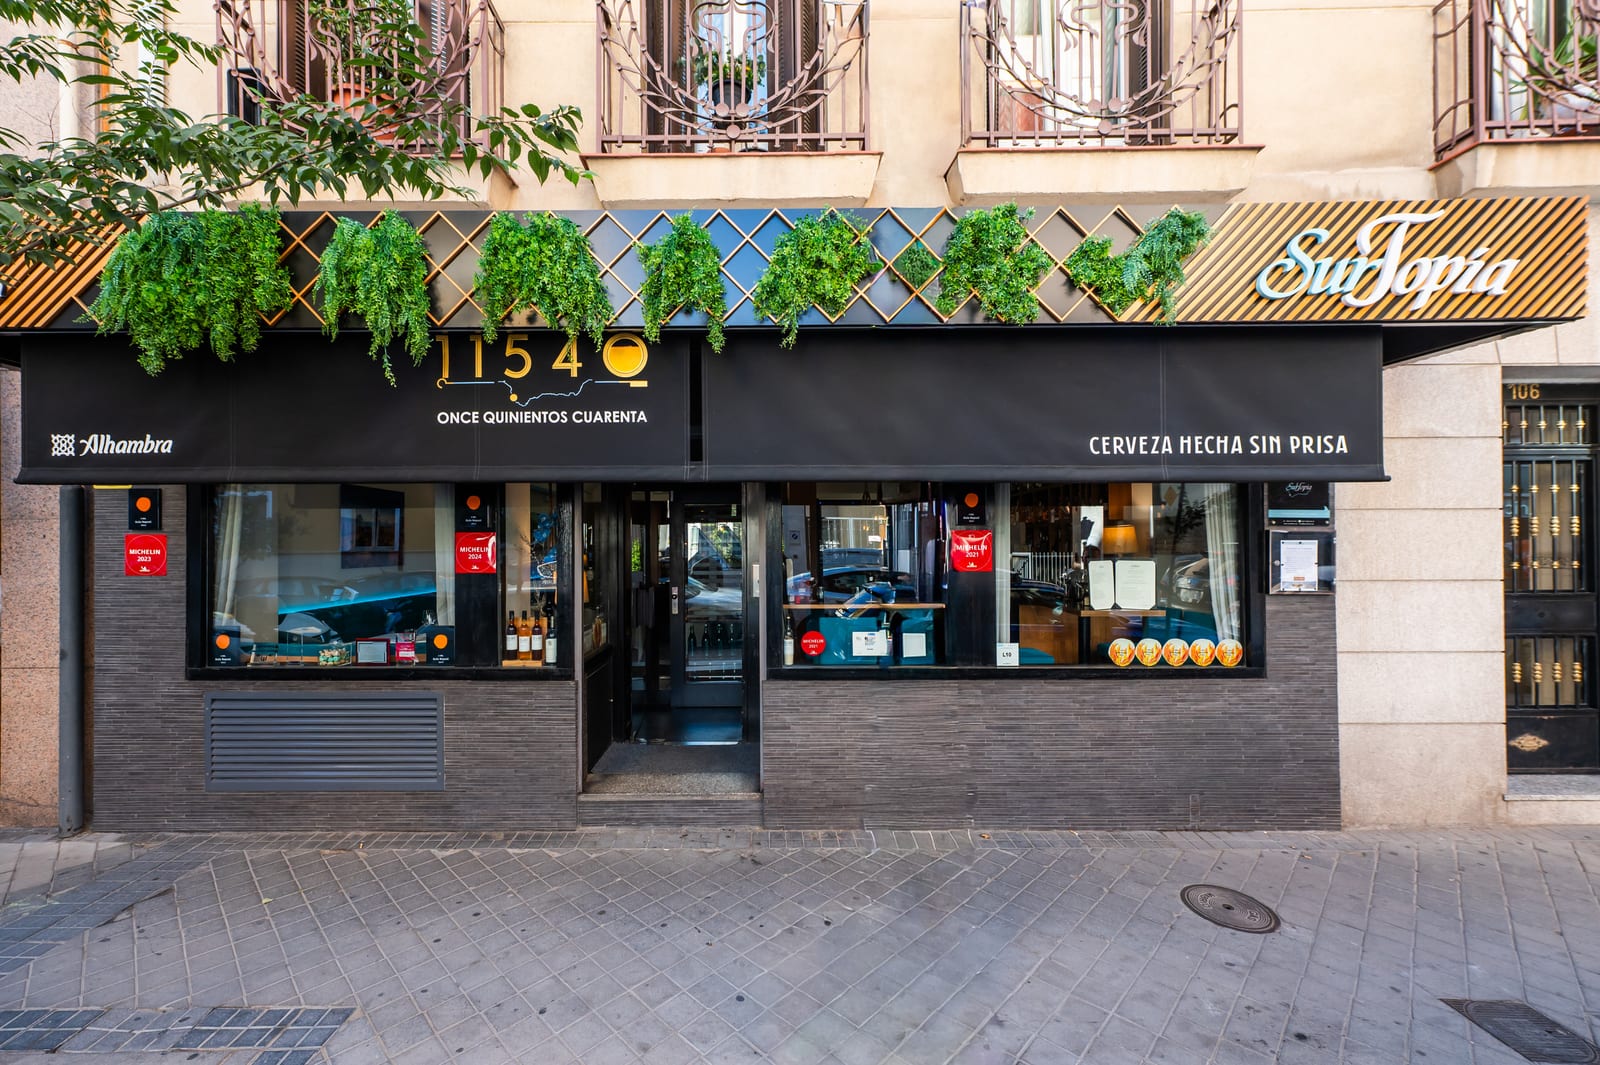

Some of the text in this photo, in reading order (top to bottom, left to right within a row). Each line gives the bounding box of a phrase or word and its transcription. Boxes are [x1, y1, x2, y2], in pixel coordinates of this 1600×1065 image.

[1509, 384, 1540, 400] 106
[437, 410, 648, 425] ONCE QUINIENTOS CUARENTA
[79, 434, 173, 456] Alhambra
[1089, 435, 1348, 455] CERVEZA HECHA SIN PRISA
